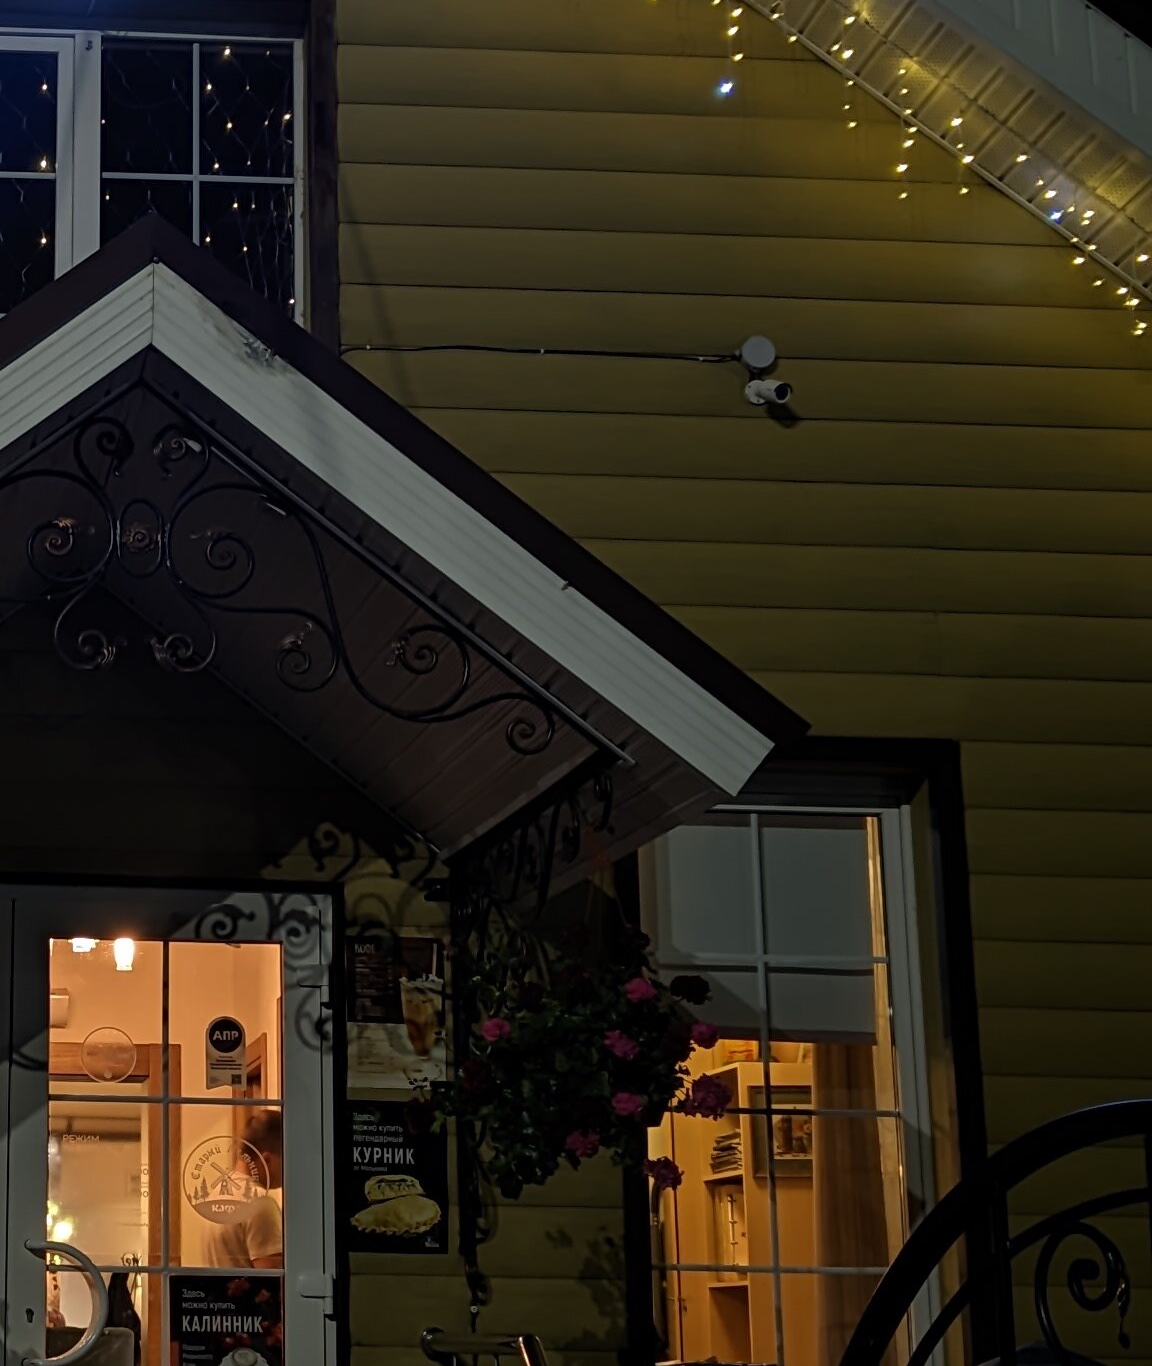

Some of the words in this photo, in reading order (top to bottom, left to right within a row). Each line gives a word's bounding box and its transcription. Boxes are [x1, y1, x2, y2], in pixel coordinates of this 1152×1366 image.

[212, 1030, 239, 1041] АПР
[62, 1134, 100, 1143] РЕЖИМ
[353, 1146, 415, 1165] КУРНИК
[191, 1144, 223, 1181] Старый
[211, 1203, 240, 1215] каф
[182, 1288, 206, 1298] Здесь
[182, 1301, 208, 1309] можно
[209, 1302, 236, 1312] купить
[182, 1315, 264, 1333] КАЛИННИК
